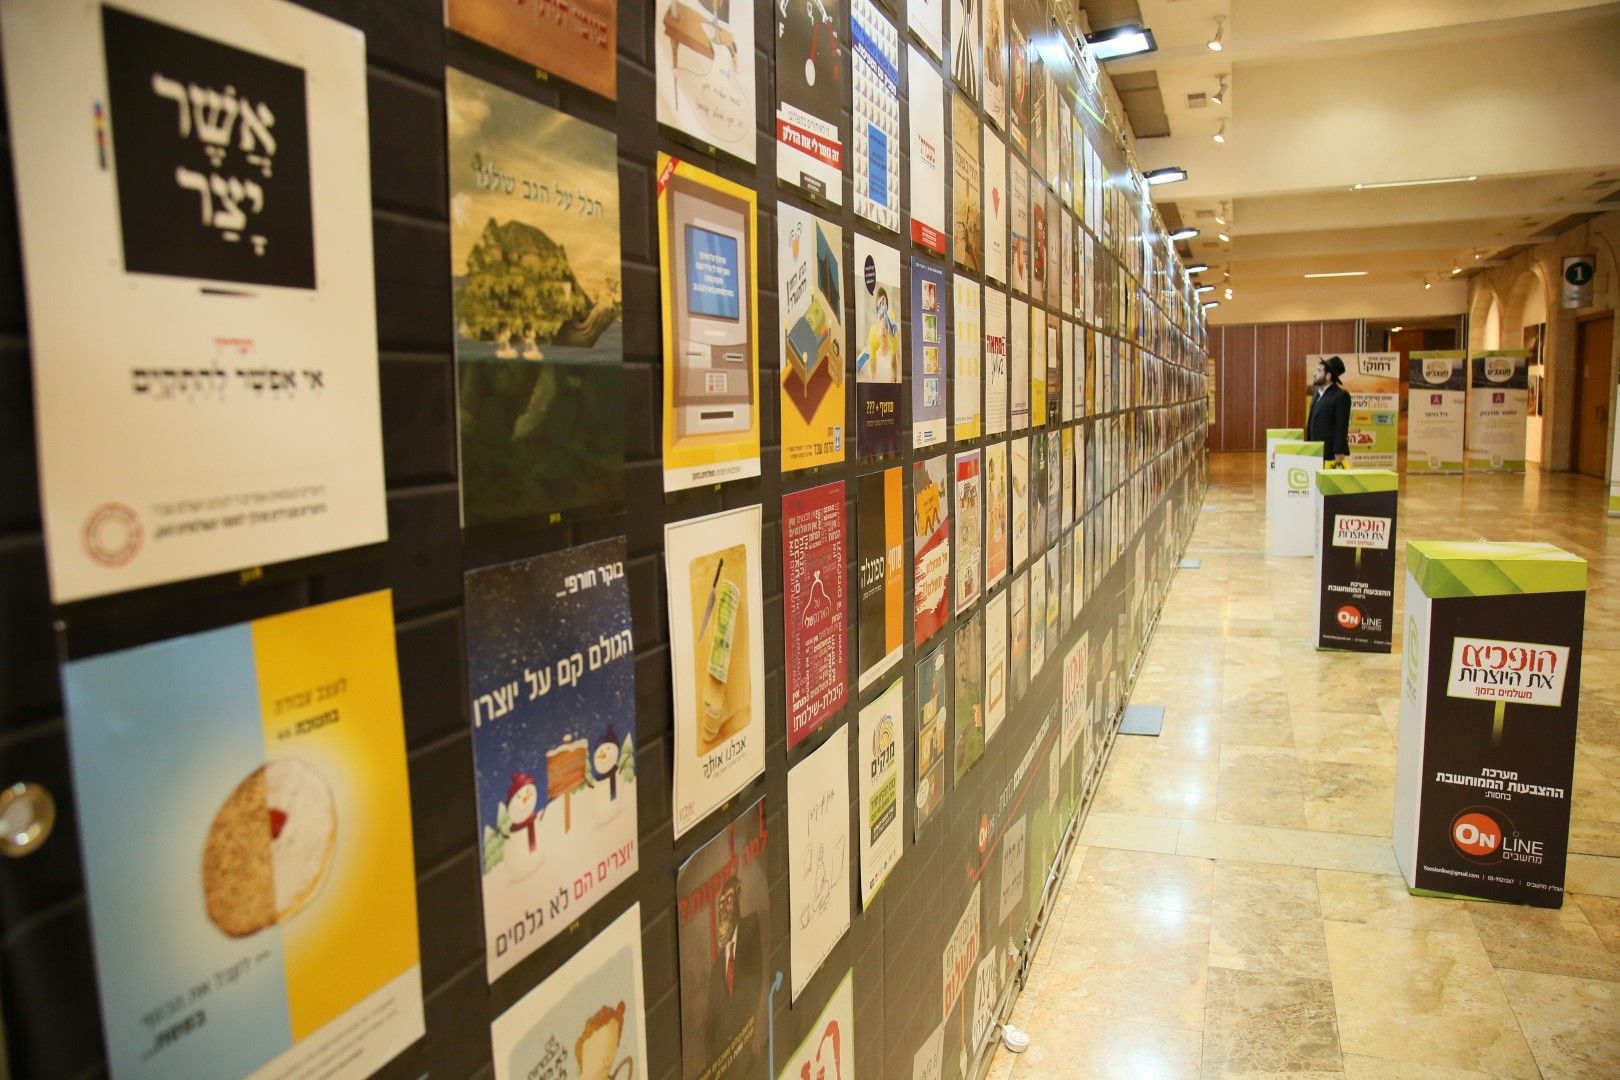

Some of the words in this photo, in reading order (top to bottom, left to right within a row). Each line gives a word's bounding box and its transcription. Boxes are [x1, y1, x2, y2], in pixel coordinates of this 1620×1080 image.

[1574, 266, 1585, 281] 1
[1362, 359, 1391, 373] רחוק!
[598, 560, 625, 588] בוקר
[1361, 617, 1382, 627] LINE
[588, 628, 634, 672] הגולם
[556, 651, 584, 689] קם
[1458, 666, 1522, 687] היוצרות
[523, 665, 552, 701] על
[1475, 685, 1495, 696] בזמן!
[1526, 672, 1555, 690] את
[1497, 688, 1533, 699] משלמים
[473, 680, 520, 728] יוצרו
[1435, 771, 1504, 791] הממוחשבת
[1481, 767, 1518, 781] מערכת
[1484, 791, 1512, 801] בחסות:
[1507, 782, 1565, 799] ההצבעות
[1502, 836, 1544, 857] LINE
[597, 840, 634, 884] יוצרים
[1502, 851, 1543, 865] מחשבים
[573, 871, 594, 901] הם
[550, 885, 570, 919] לא
[496, 907, 545, 957] גלמים
